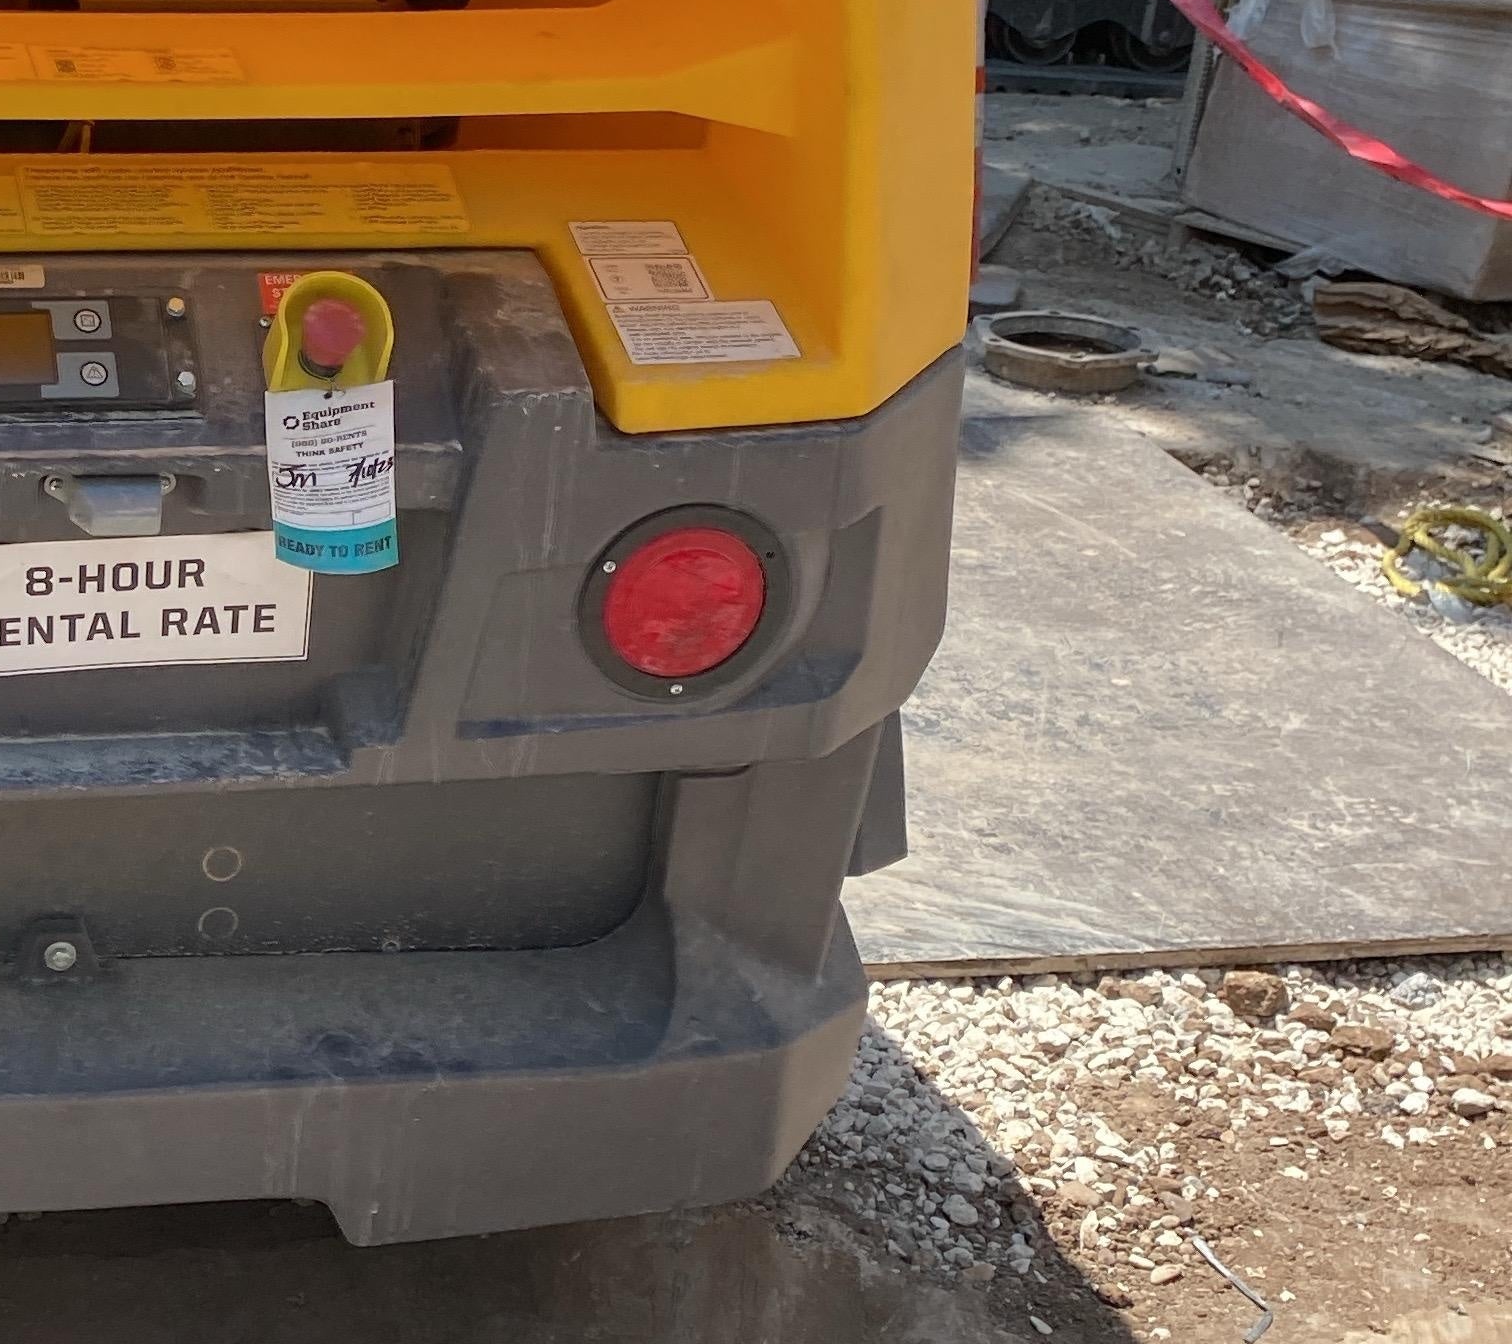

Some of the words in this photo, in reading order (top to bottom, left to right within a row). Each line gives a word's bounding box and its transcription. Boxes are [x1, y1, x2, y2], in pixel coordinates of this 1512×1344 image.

[302, 400, 376, 421] Equipment
[302, 417, 341, 431] Share
[295, 449, 326, 458] THINK
[328, 441, 365, 455] SAFETY
[278, 536, 325, 557] READY
[328, 545, 348, 557] TO
[354, 535, 392, 557] RENT
[25, 557, 206, 597] 8-HOUR
[160, 603, 278, 637] RATE
